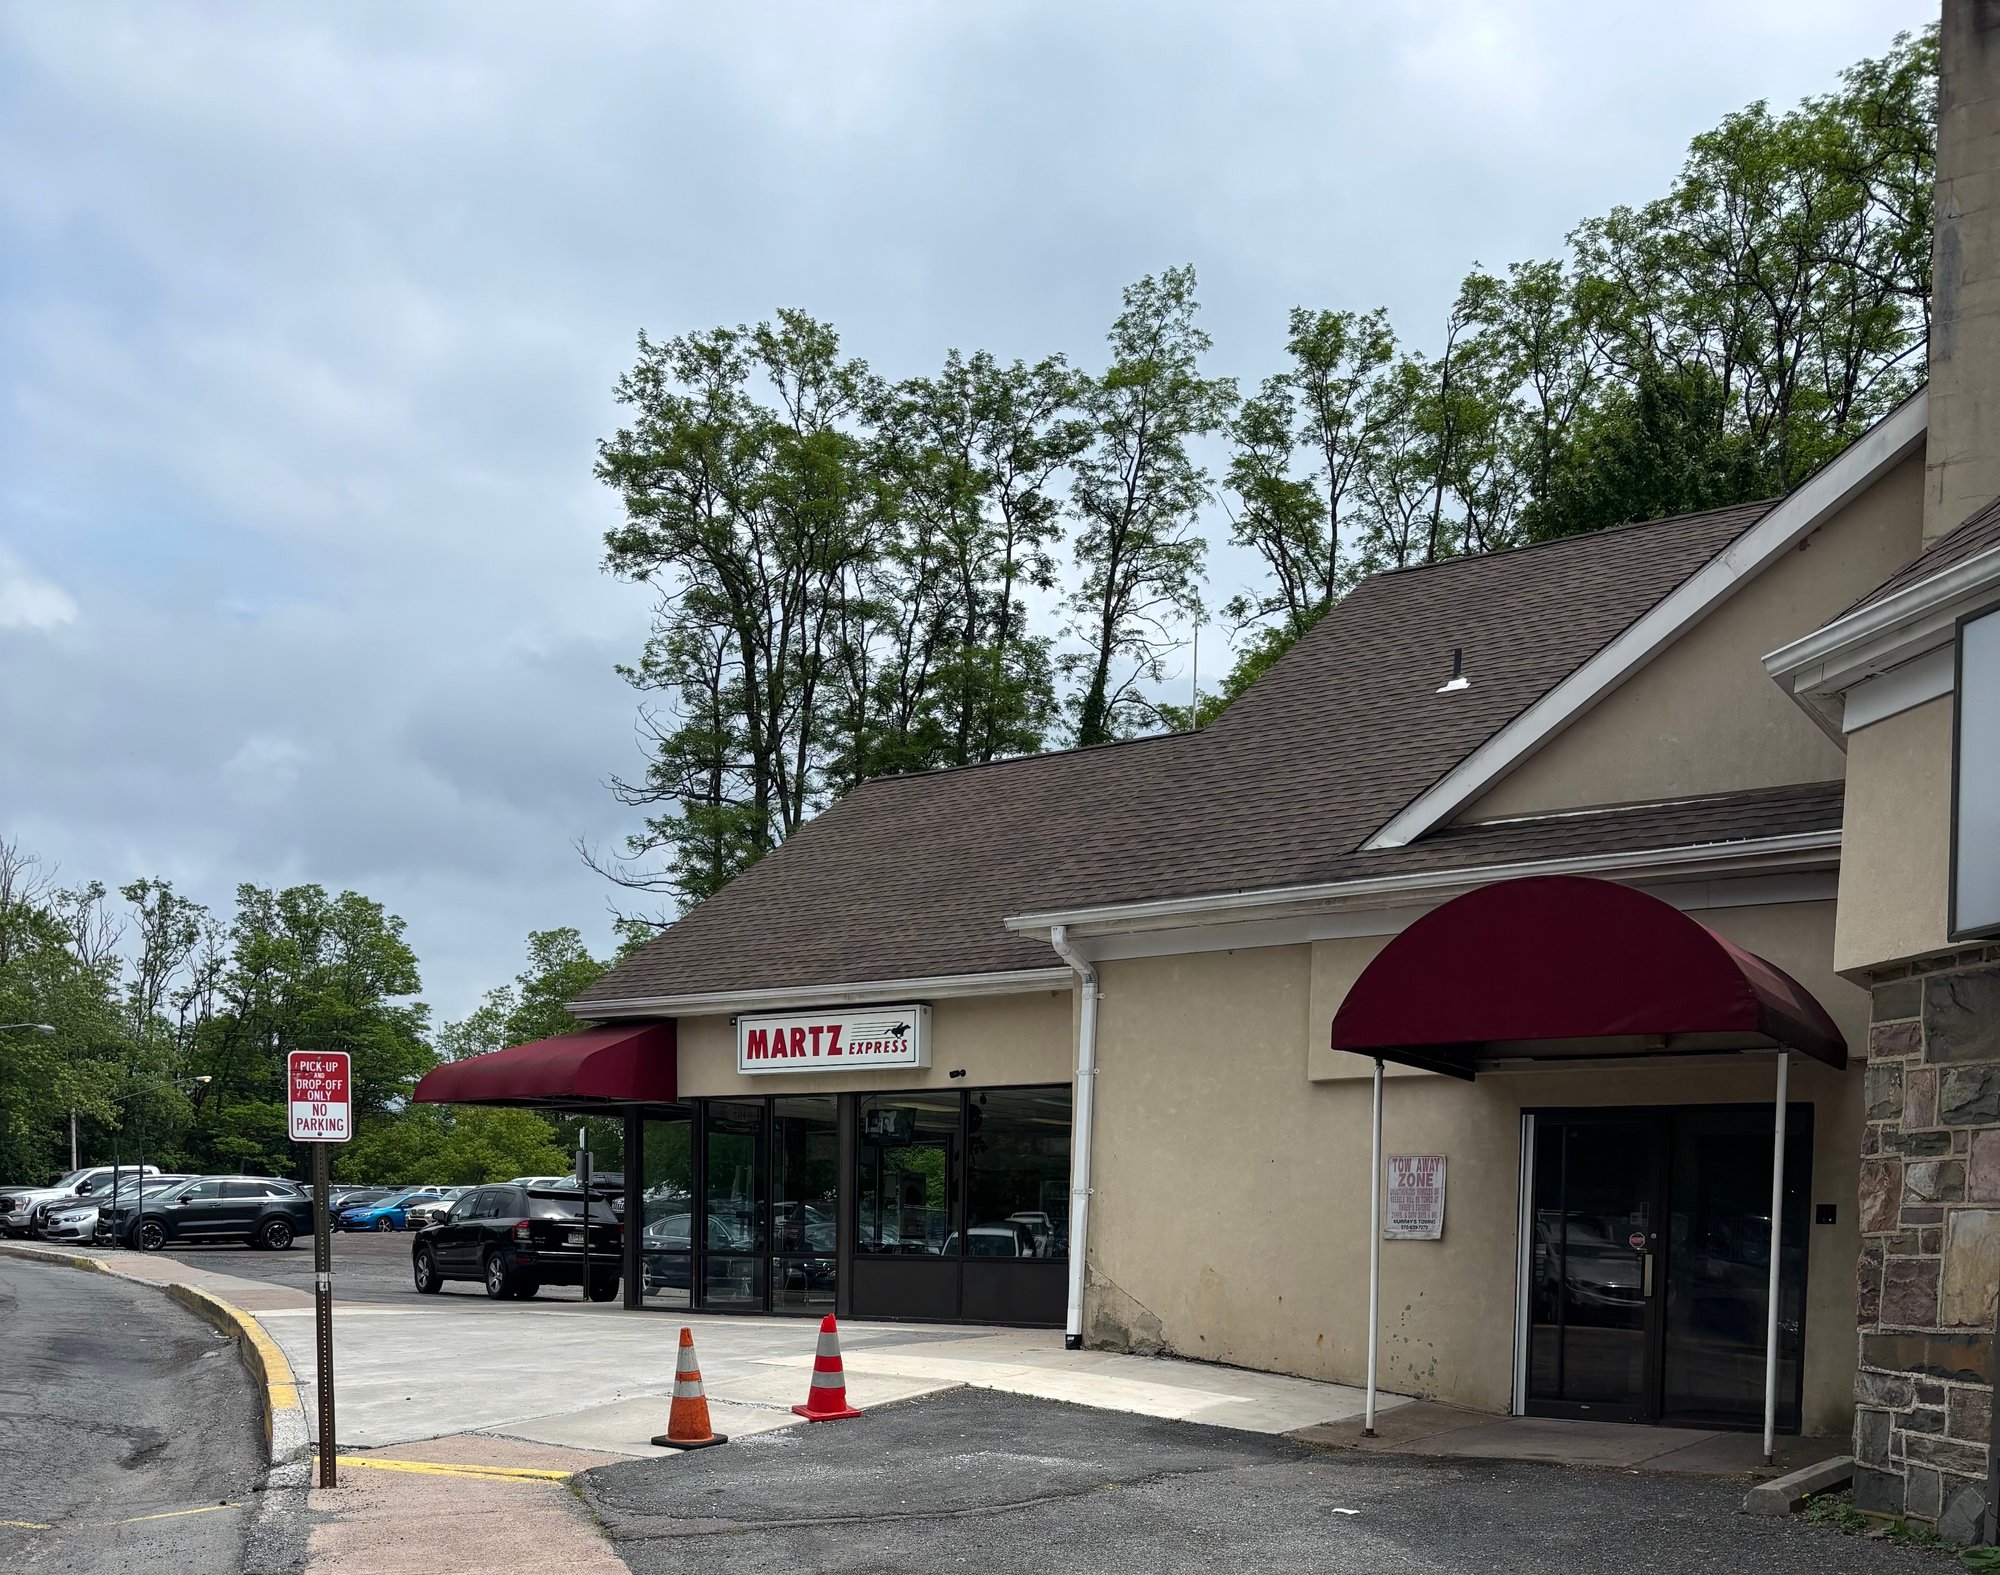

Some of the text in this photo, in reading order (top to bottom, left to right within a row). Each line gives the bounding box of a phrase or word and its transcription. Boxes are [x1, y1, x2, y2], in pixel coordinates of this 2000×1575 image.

[747, 1025, 908, 1060] MARTZ EXPRESS
[300, 1061, 339, 1072] PICK-UP
[296, 1079, 343, 1090] DROP-OFF
[307, 1090, 332, 1101] ONLY
[312, 1103, 327, 1117] NO
[296, 1118, 344, 1131] PARKING
[1392, 1158, 1441, 1173] TOW AWAY
[1398, 1173, 1434, 1188] ZONE
